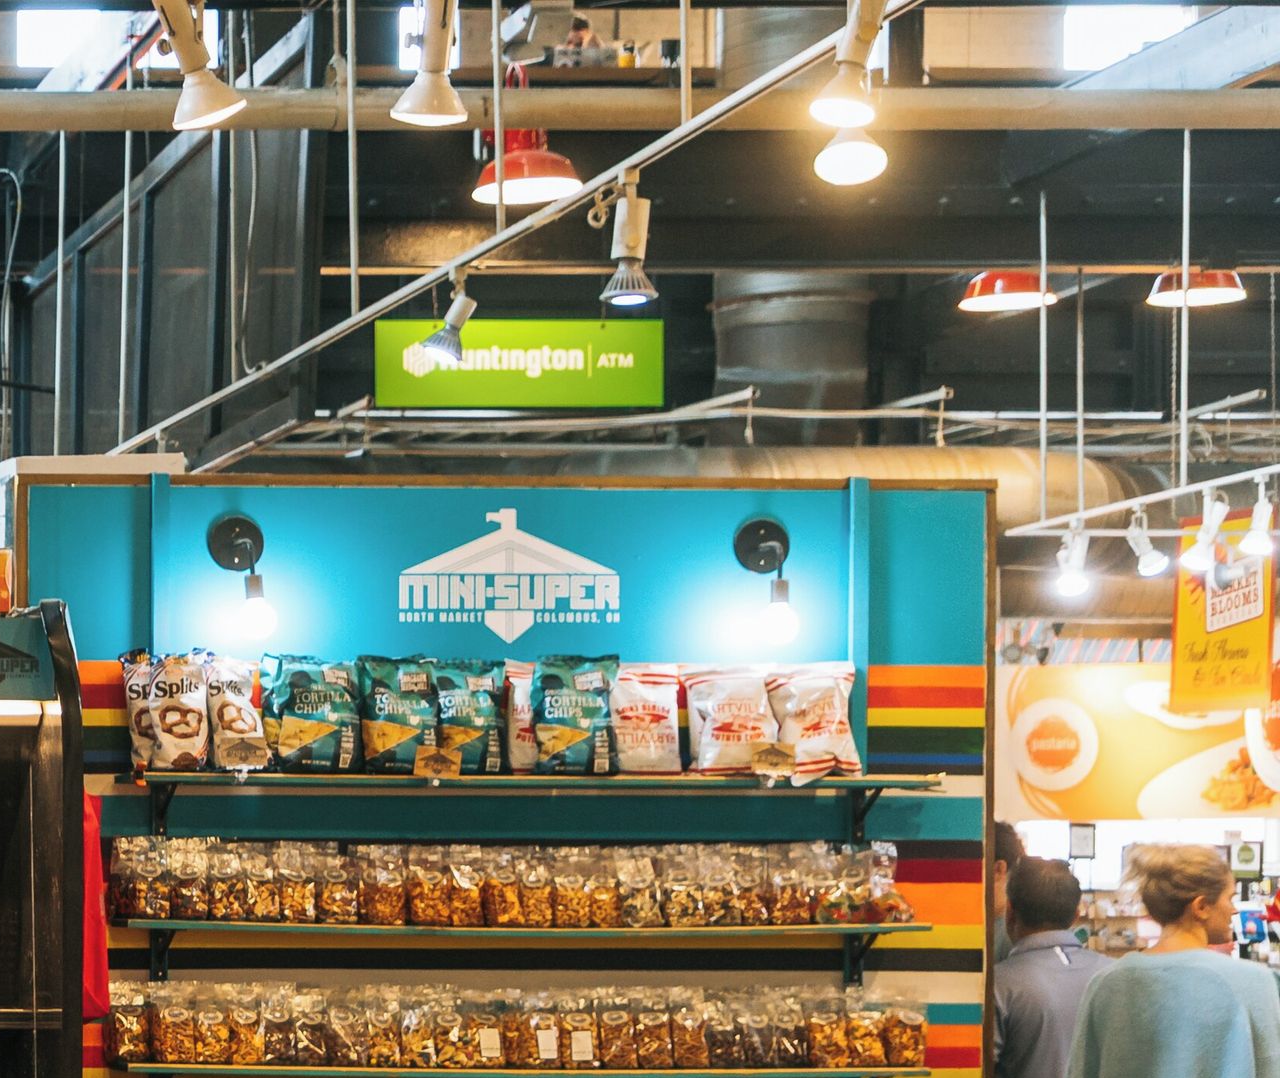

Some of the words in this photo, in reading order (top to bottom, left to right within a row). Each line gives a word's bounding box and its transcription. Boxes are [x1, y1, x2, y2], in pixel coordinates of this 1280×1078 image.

[596, 353, 633, 368] ATM
[399, 574, 620, 610] MINI-SUPER
[1211, 588, 1259, 617] BLOOMS
[399, 612, 434, 622] NORTH
[439, 612, 482, 623] MARKET
[606, 612, 621, 623] OH
[154, 678, 199, 699] Splits
[295, 689, 351, 703] TORTILLA
[374, 693, 429, 709] TORTILLA
[544, 695, 605, 708] TORTILLA
[294, 702, 331, 714] CHIPS
[374, 703, 411, 715] CHIPS
[440, 707, 476, 719] CHIPS
[544, 707, 583, 719] CHIPS
